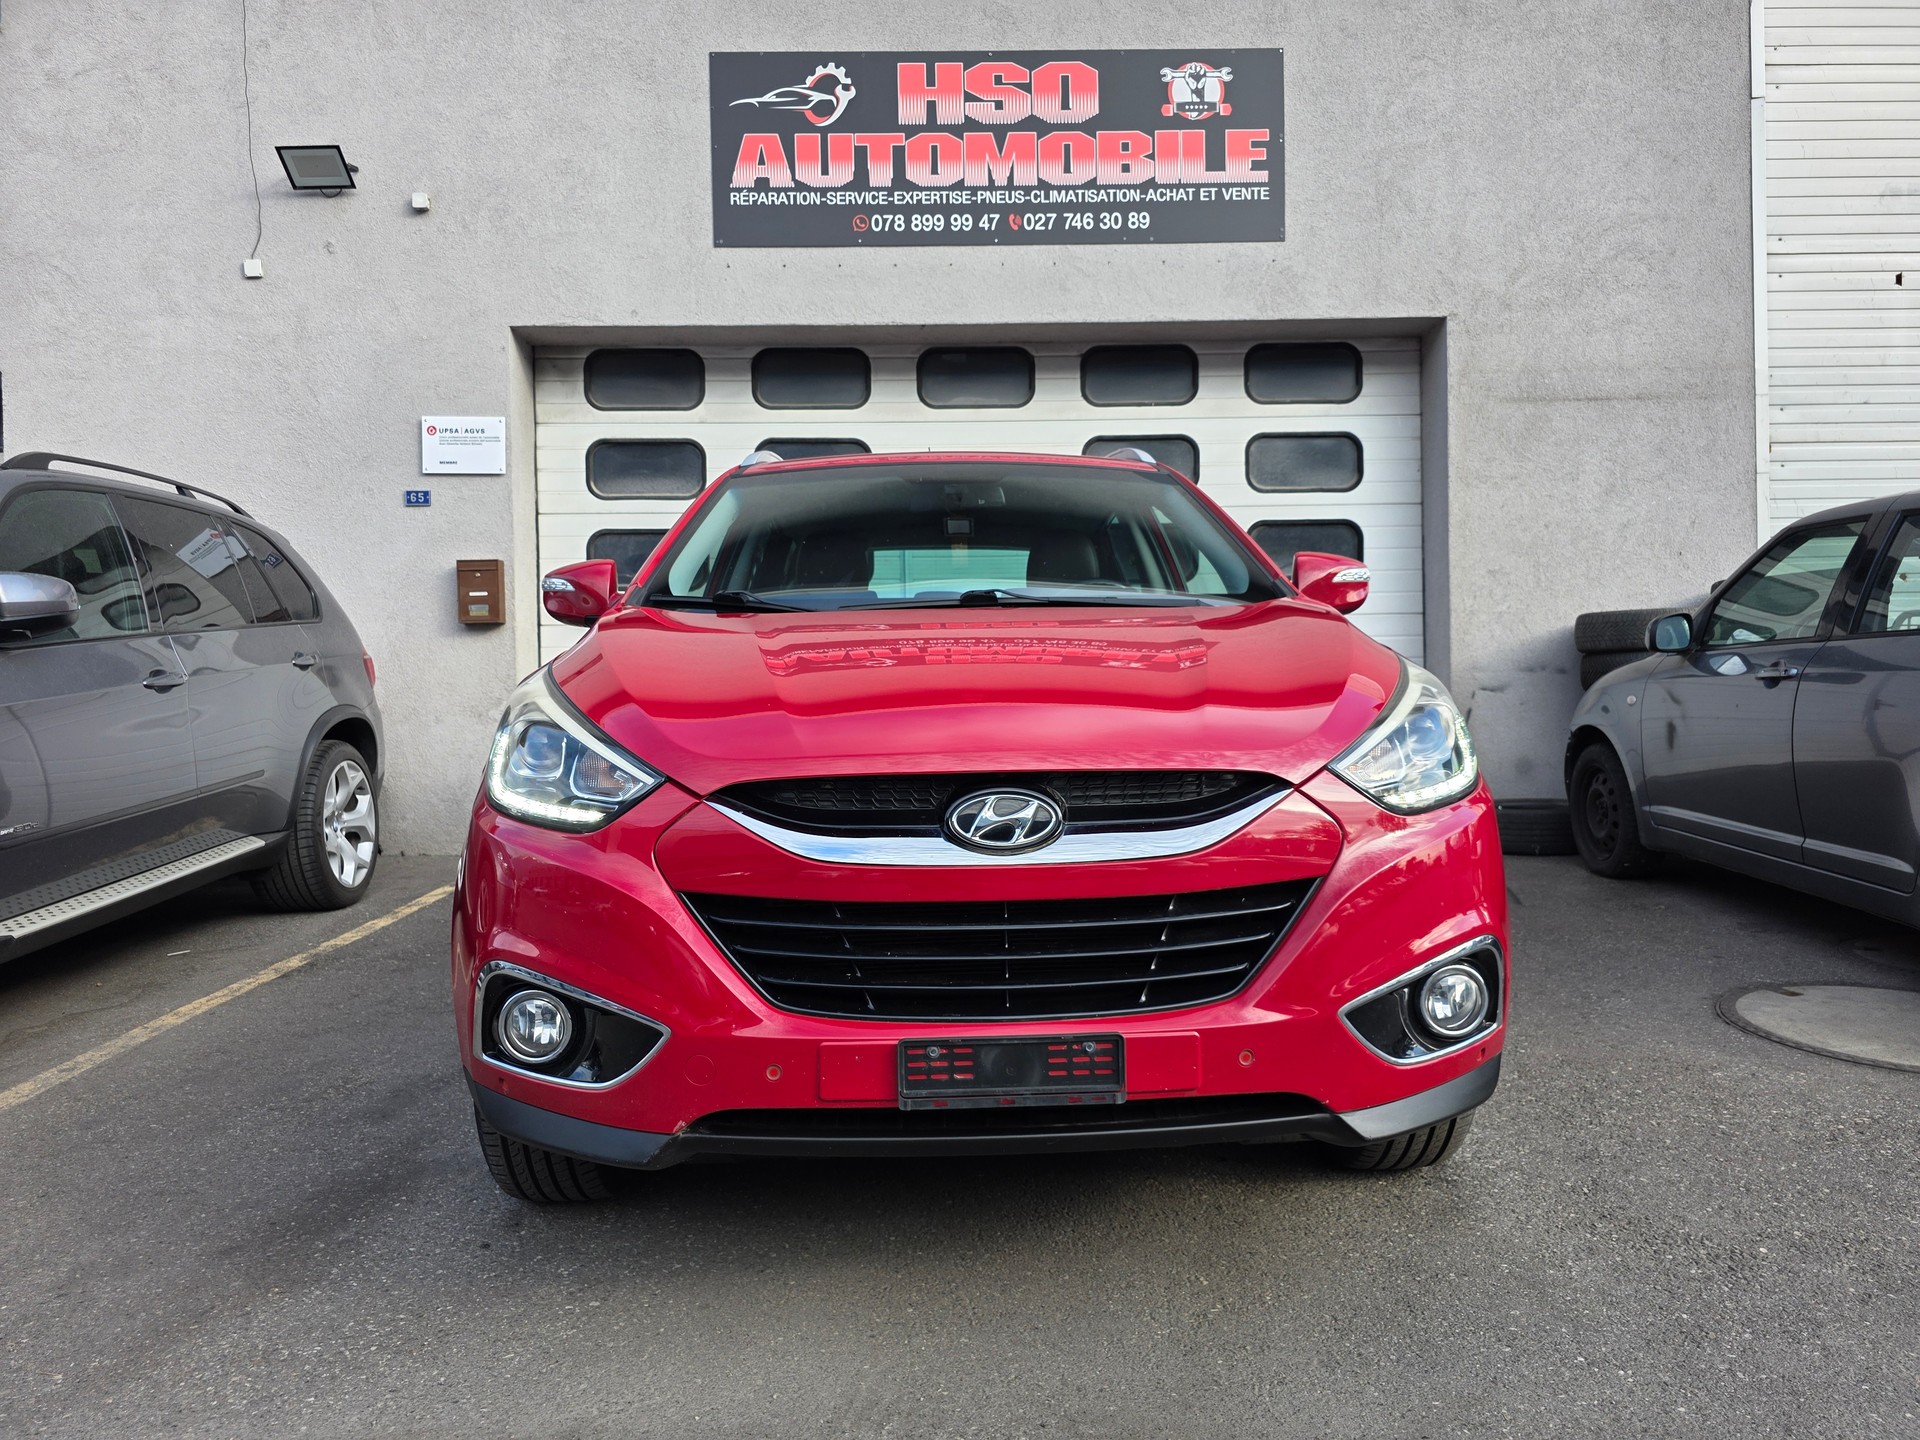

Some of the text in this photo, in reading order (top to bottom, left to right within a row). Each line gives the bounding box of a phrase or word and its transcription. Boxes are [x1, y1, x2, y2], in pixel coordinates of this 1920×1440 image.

[897, 61, 1100, 125] HSO
[729, 129, 1270, 188] AUTOMOBILE
[1200, 187, 1218, 201] ET
[1222, 187, 1270, 200] VENTE
[871, 211, 1150, 232] 078 899 99 47 027 746 30 89
[410, 492, 425, 503] 65
